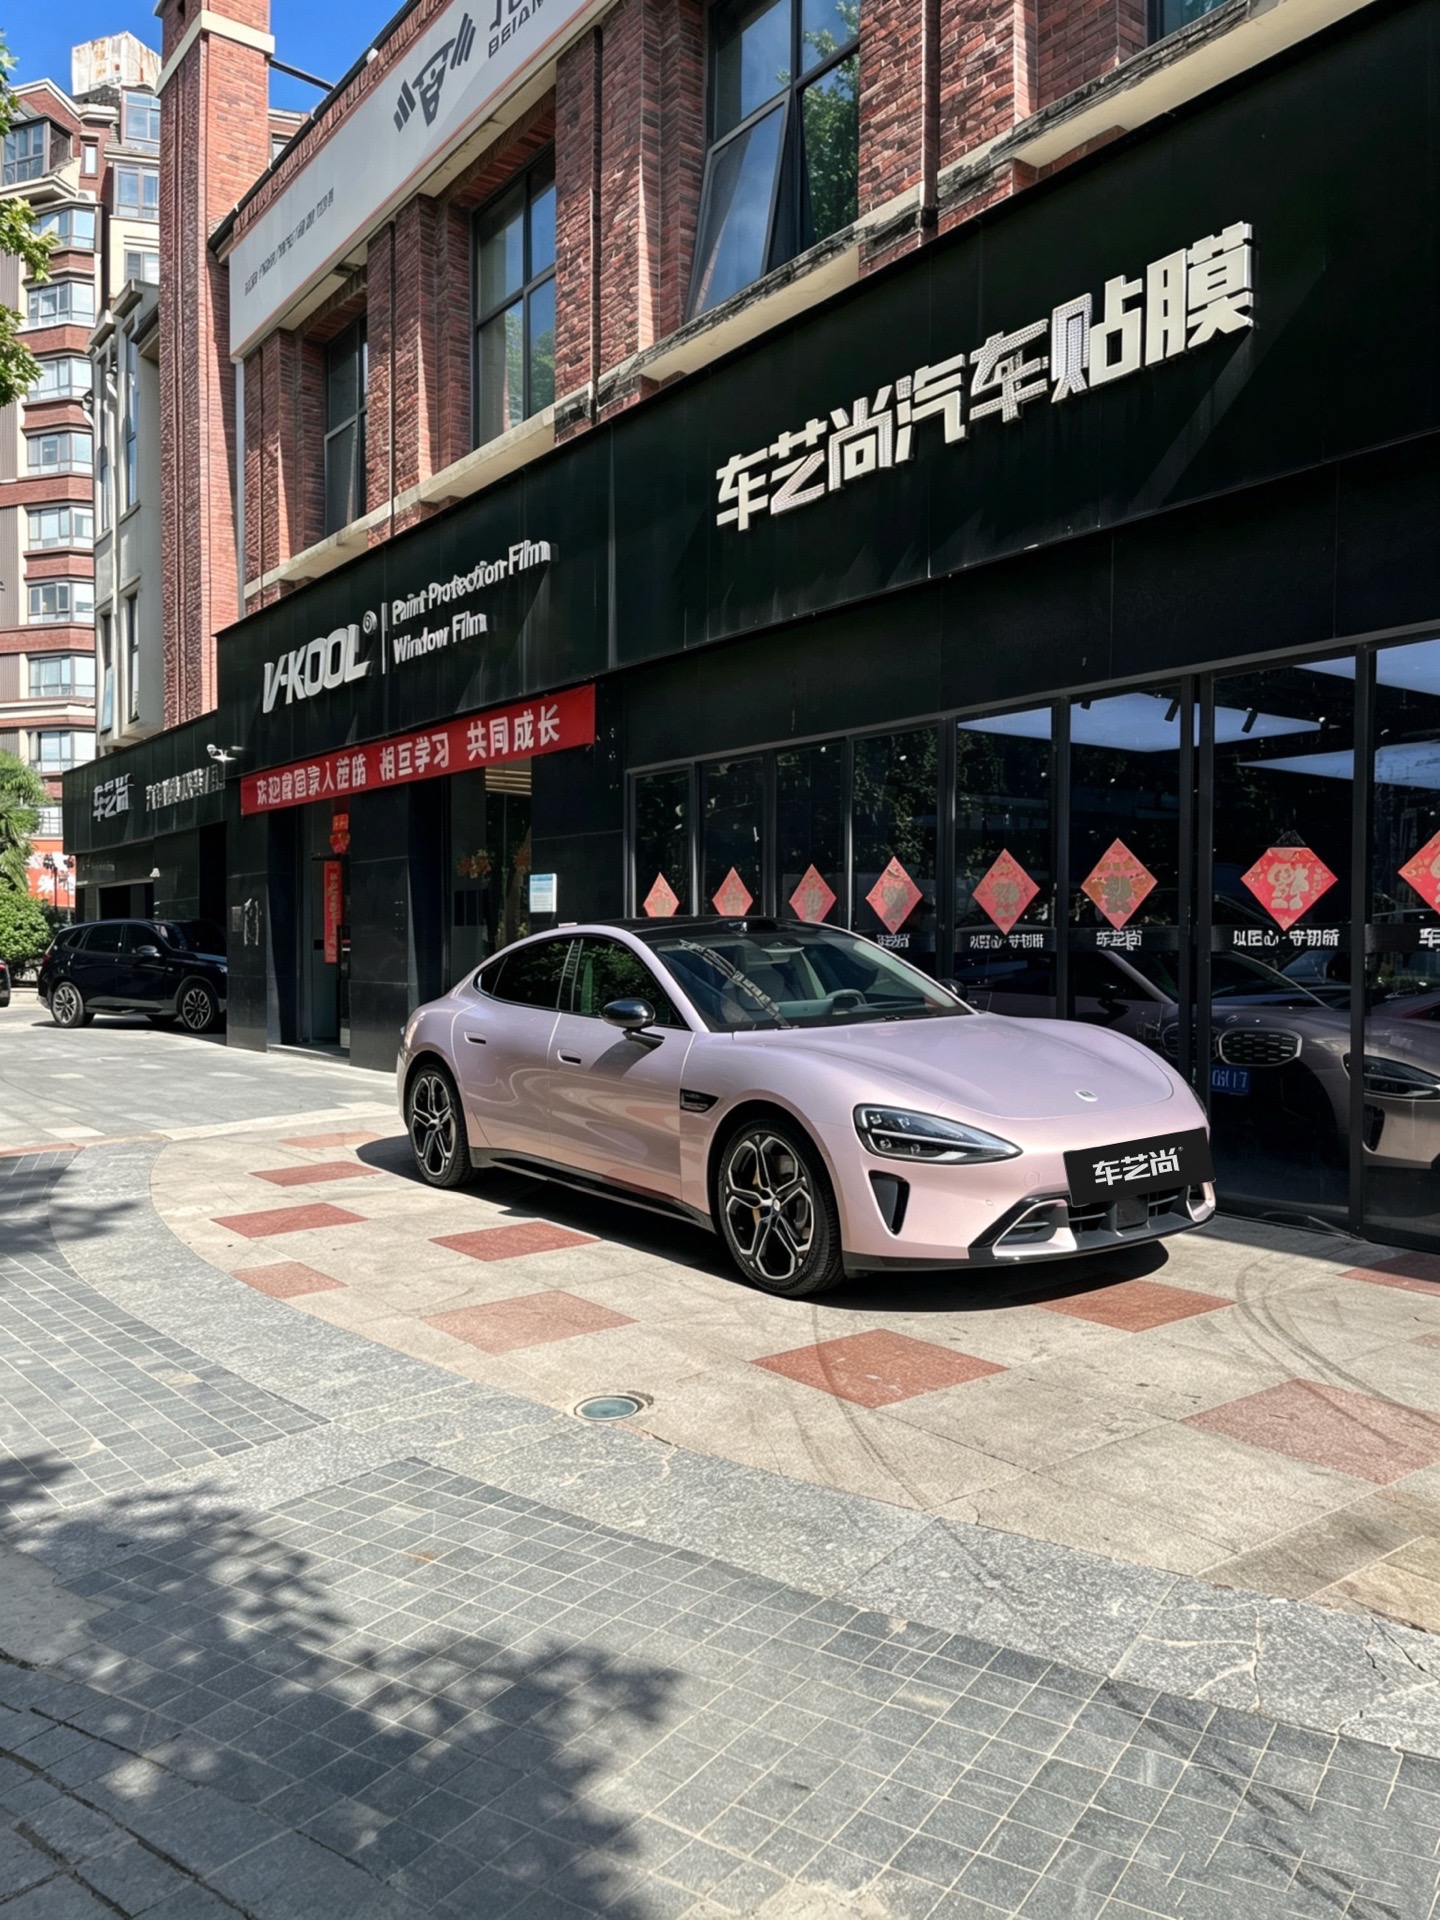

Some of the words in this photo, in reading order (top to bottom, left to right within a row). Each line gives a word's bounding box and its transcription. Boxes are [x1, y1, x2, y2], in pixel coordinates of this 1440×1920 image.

[716, 220, 1254, 531] 车艺尚汽车贴膜
[392, 590, 428, 626] Paint
[428, 559, 508, 610] Protection
[508, 540, 551, 575] Film
[393, 626, 450, 665] Window
[452, 610, 488, 643] Film
[379, 731, 450, 782] 相互学习
[466, 703, 560, 761] 共同成长
[1092, 1147, 1180, 1186] 车艺尚
